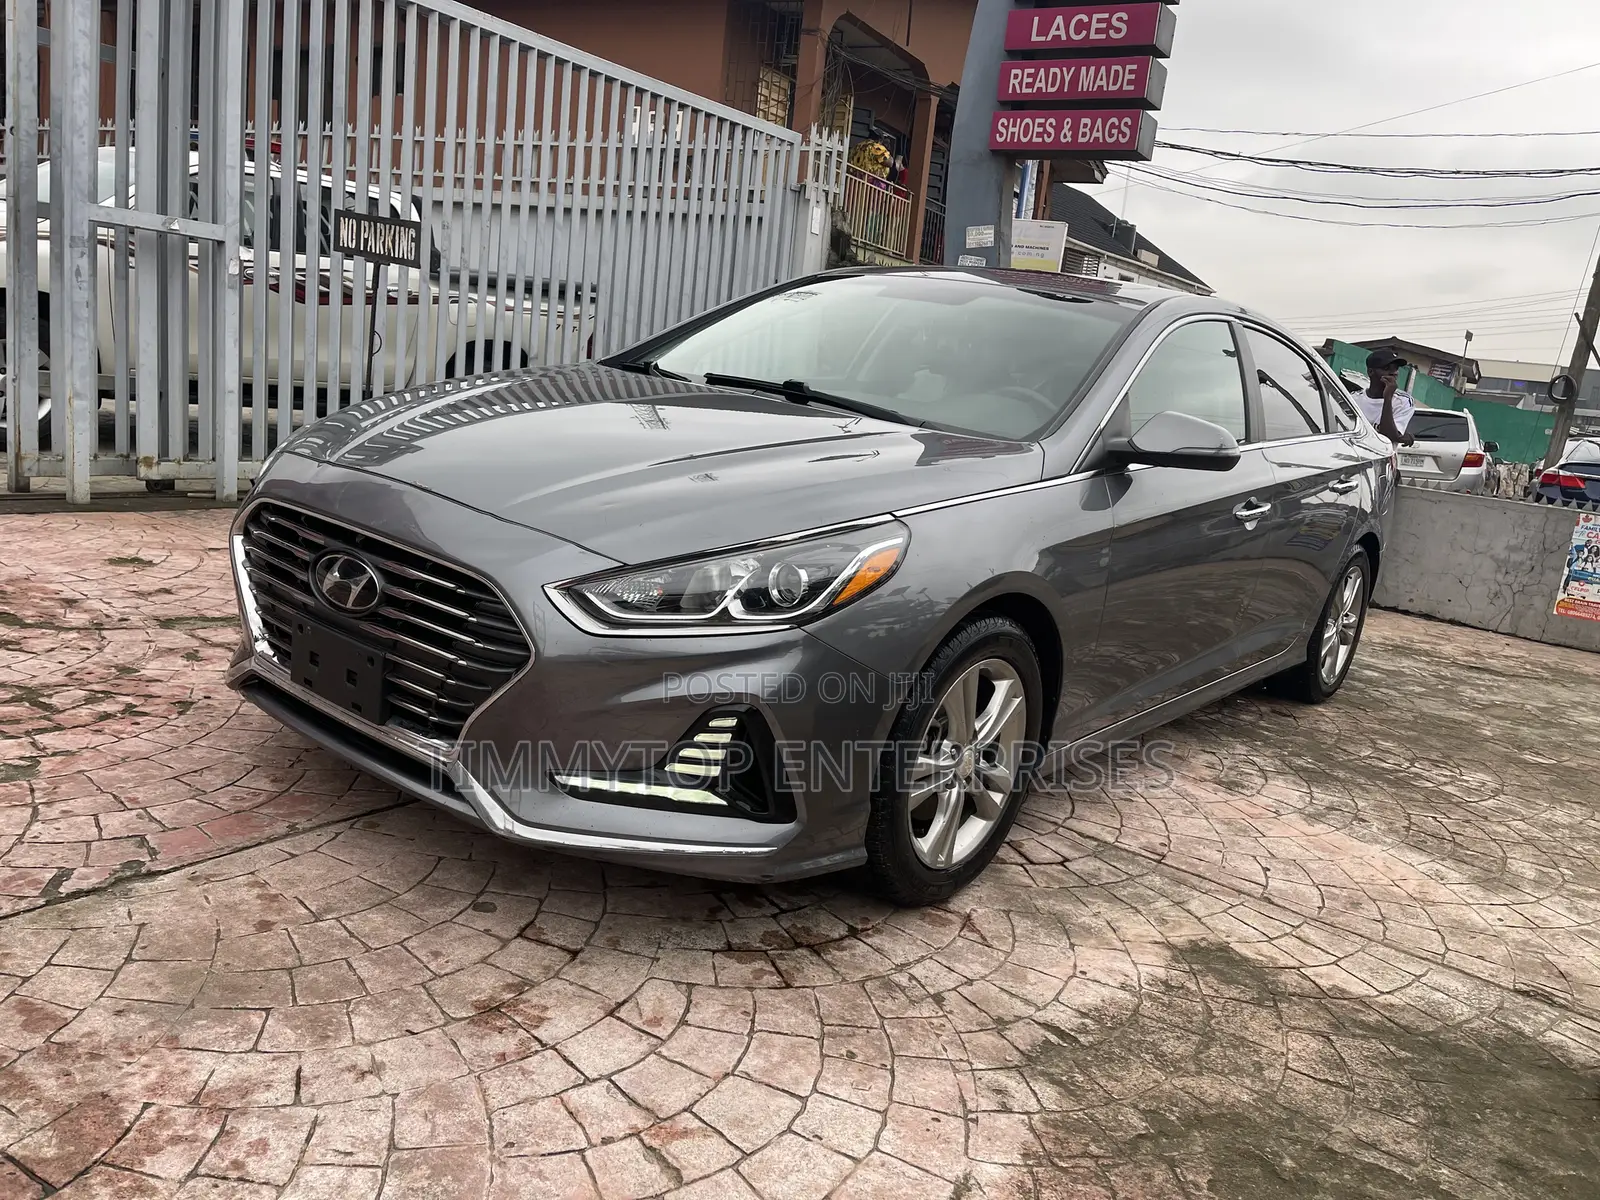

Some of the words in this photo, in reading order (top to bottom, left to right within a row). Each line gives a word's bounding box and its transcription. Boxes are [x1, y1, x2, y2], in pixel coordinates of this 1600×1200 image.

[1031, 12, 1129, 42] LACES
[1008, 66, 1075, 94] READY
[1078, 64, 1137, 92] MADE
[996, 117, 1056, 143] SHOES
[1060, 117, 1072, 143] &
[1078, 117, 1132, 143] BAGS
[340, 216, 357, 249] NO
[360, 219, 416, 261] PARKING
